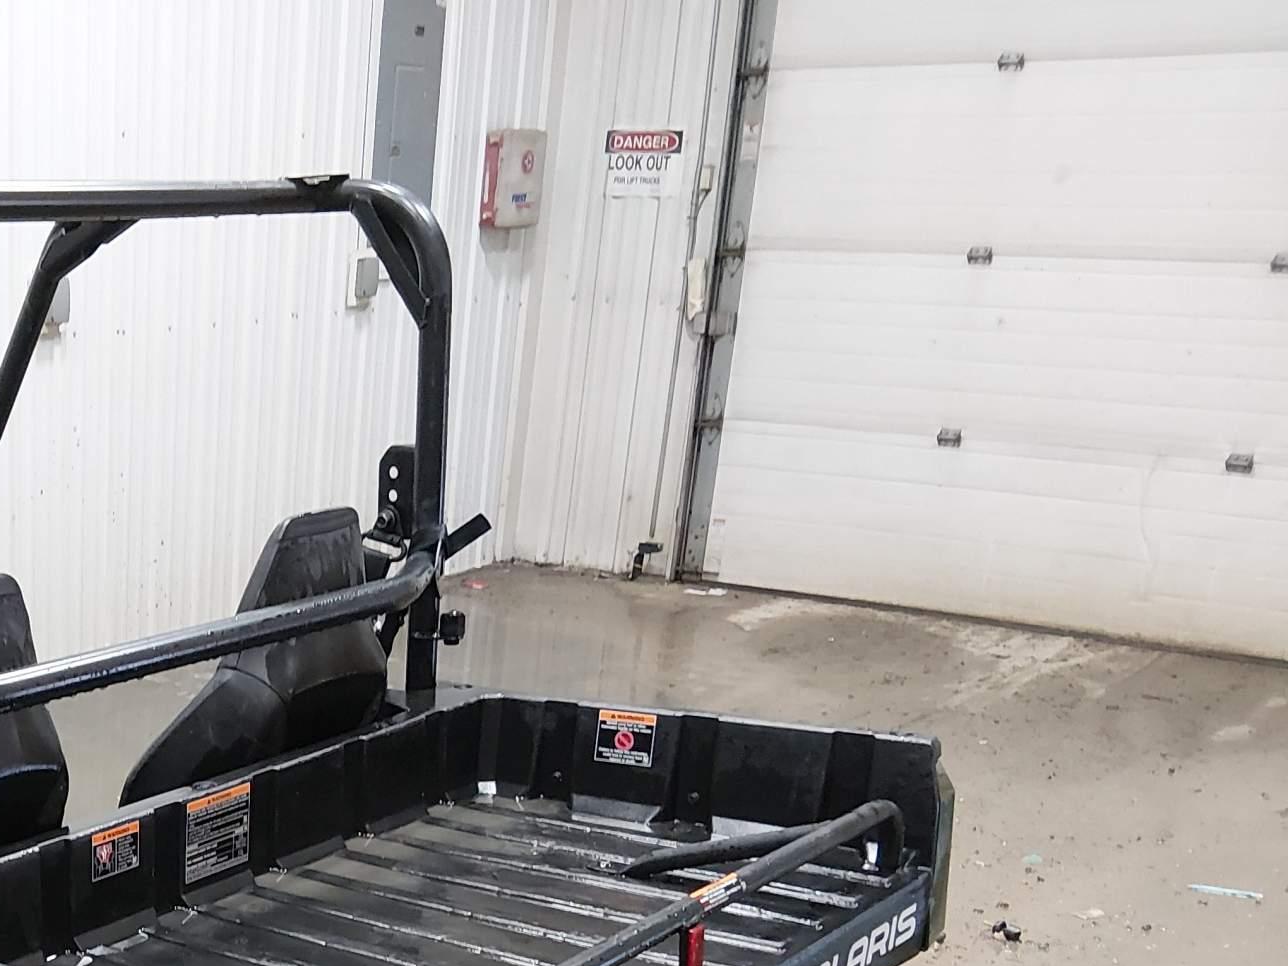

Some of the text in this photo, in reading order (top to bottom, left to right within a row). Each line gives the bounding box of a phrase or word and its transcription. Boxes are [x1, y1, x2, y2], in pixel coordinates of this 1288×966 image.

[613, 135, 670, 150] DANGER
[608, 155, 672, 171] LOOK OUT
